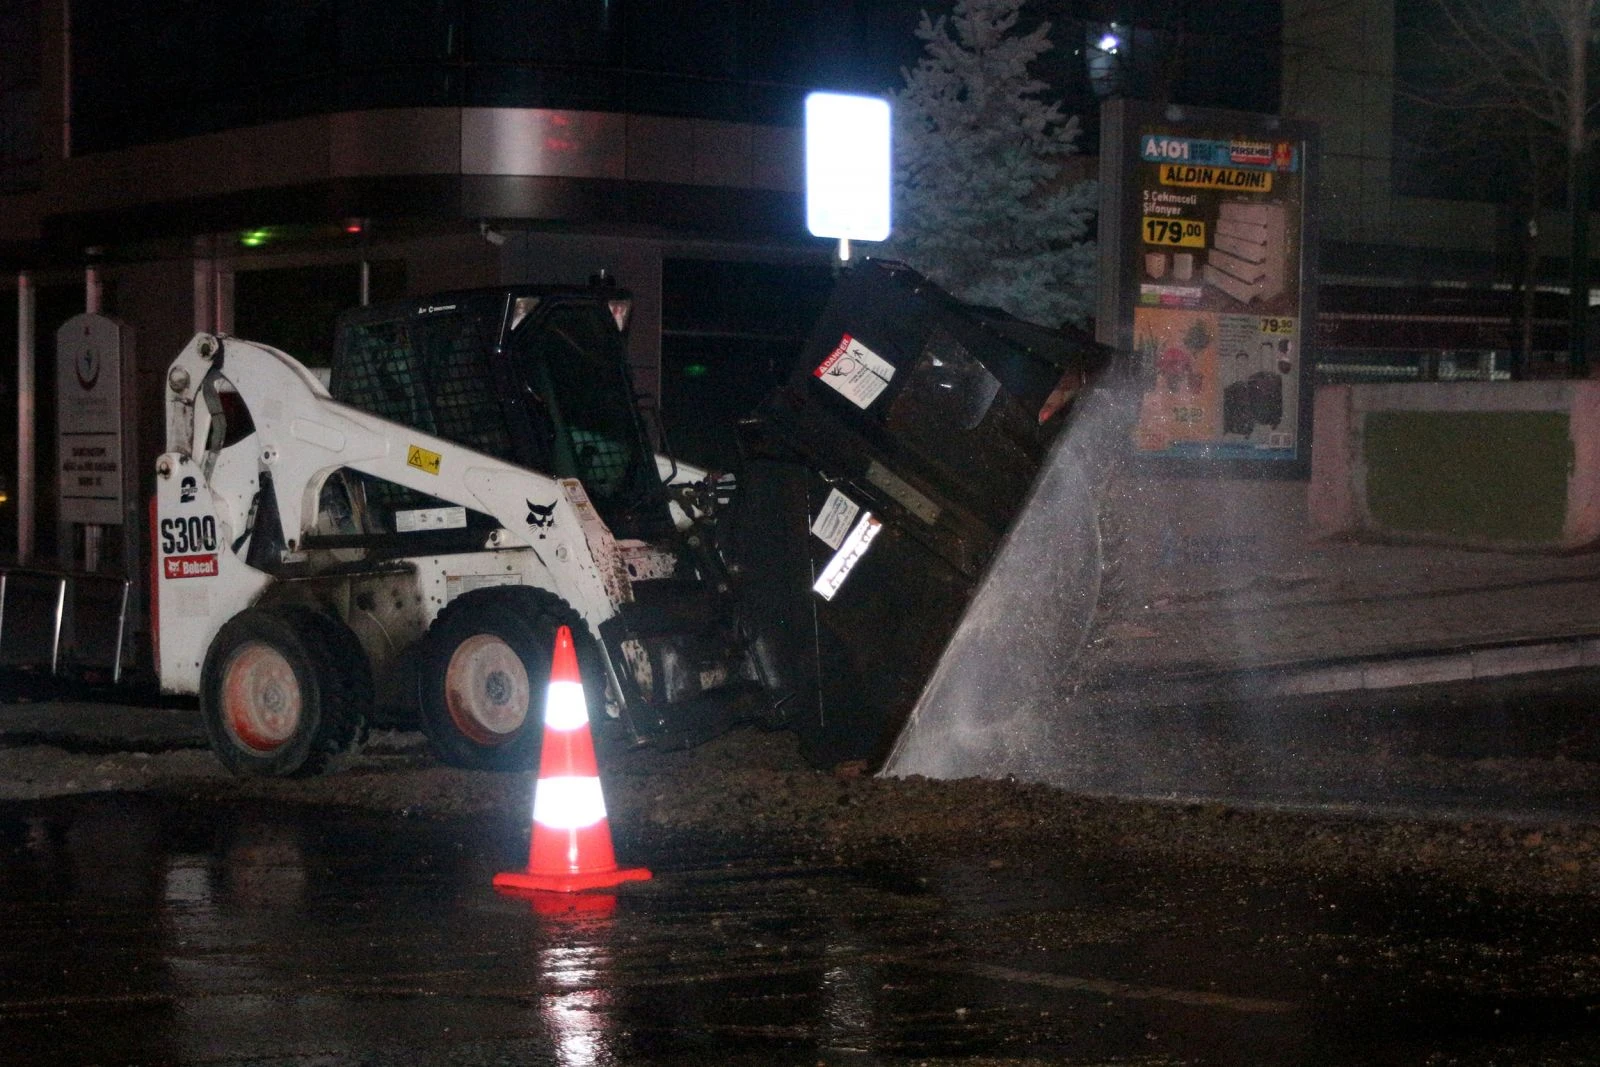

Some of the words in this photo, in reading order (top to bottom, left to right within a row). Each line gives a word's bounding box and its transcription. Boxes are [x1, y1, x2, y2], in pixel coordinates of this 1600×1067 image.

[1166, 166, 1213, 184] ALDIN
[1215, 171, 1266, 188] ALDIN!
[160, 515, 217, 554] S300
[182, 560, 214, 575] Bobcat
